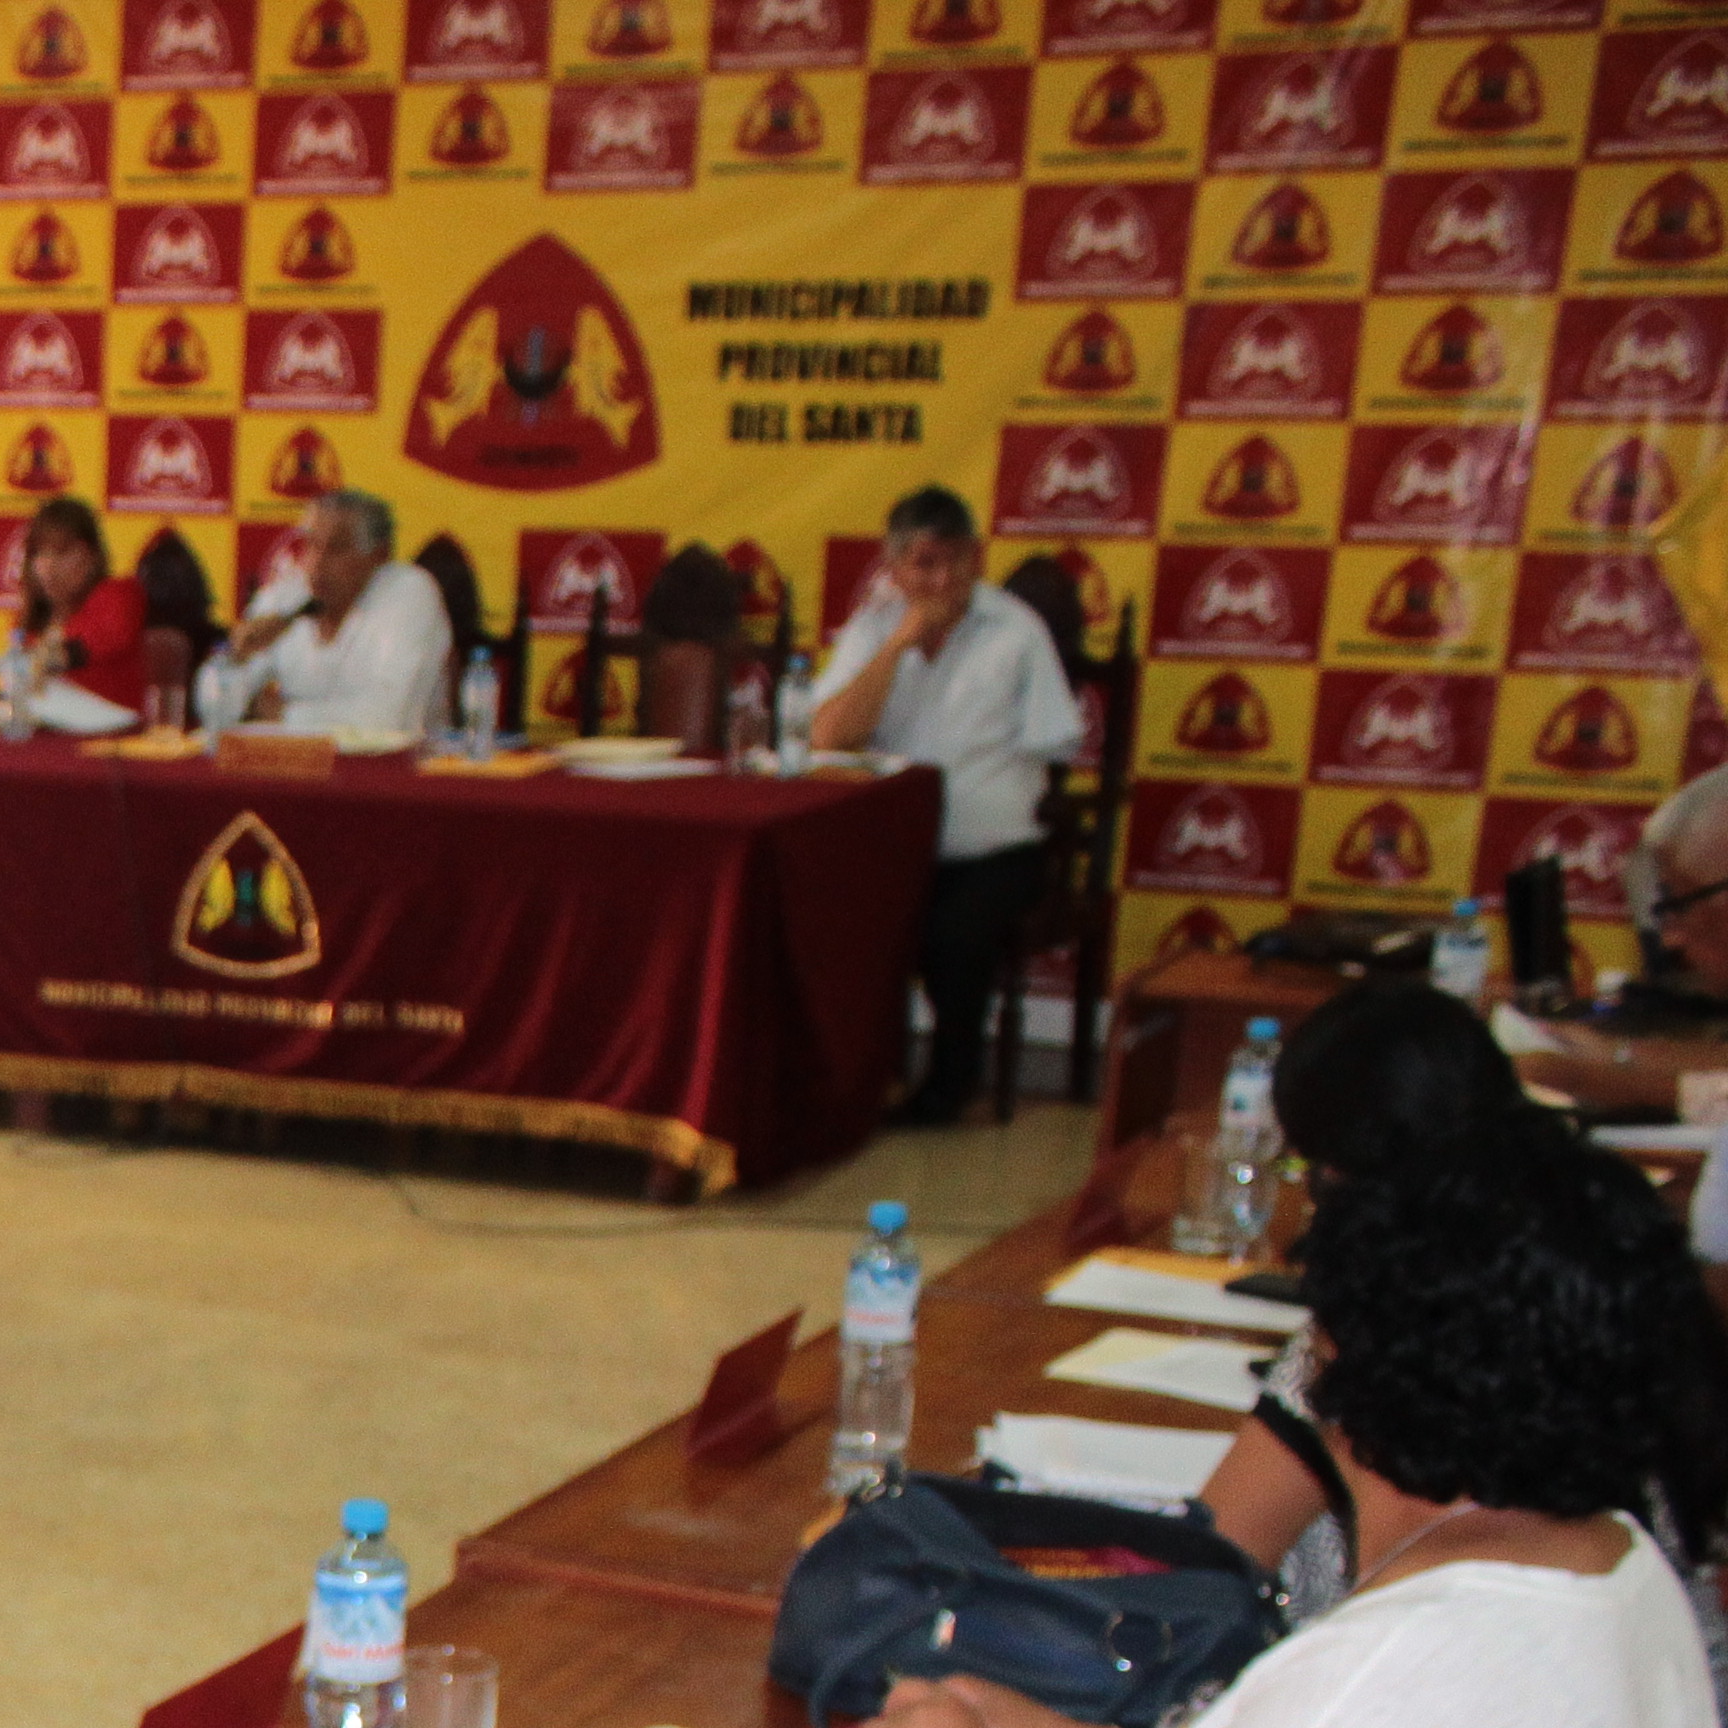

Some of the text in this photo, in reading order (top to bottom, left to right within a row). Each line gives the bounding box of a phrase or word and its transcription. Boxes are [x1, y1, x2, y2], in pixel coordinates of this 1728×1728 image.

[688, 279, 991, 320] MUNICIPALIDAD
[718, 341, 943, 382] PROVINCIAL
[730, 402, 923, 443] DEL SANTA
